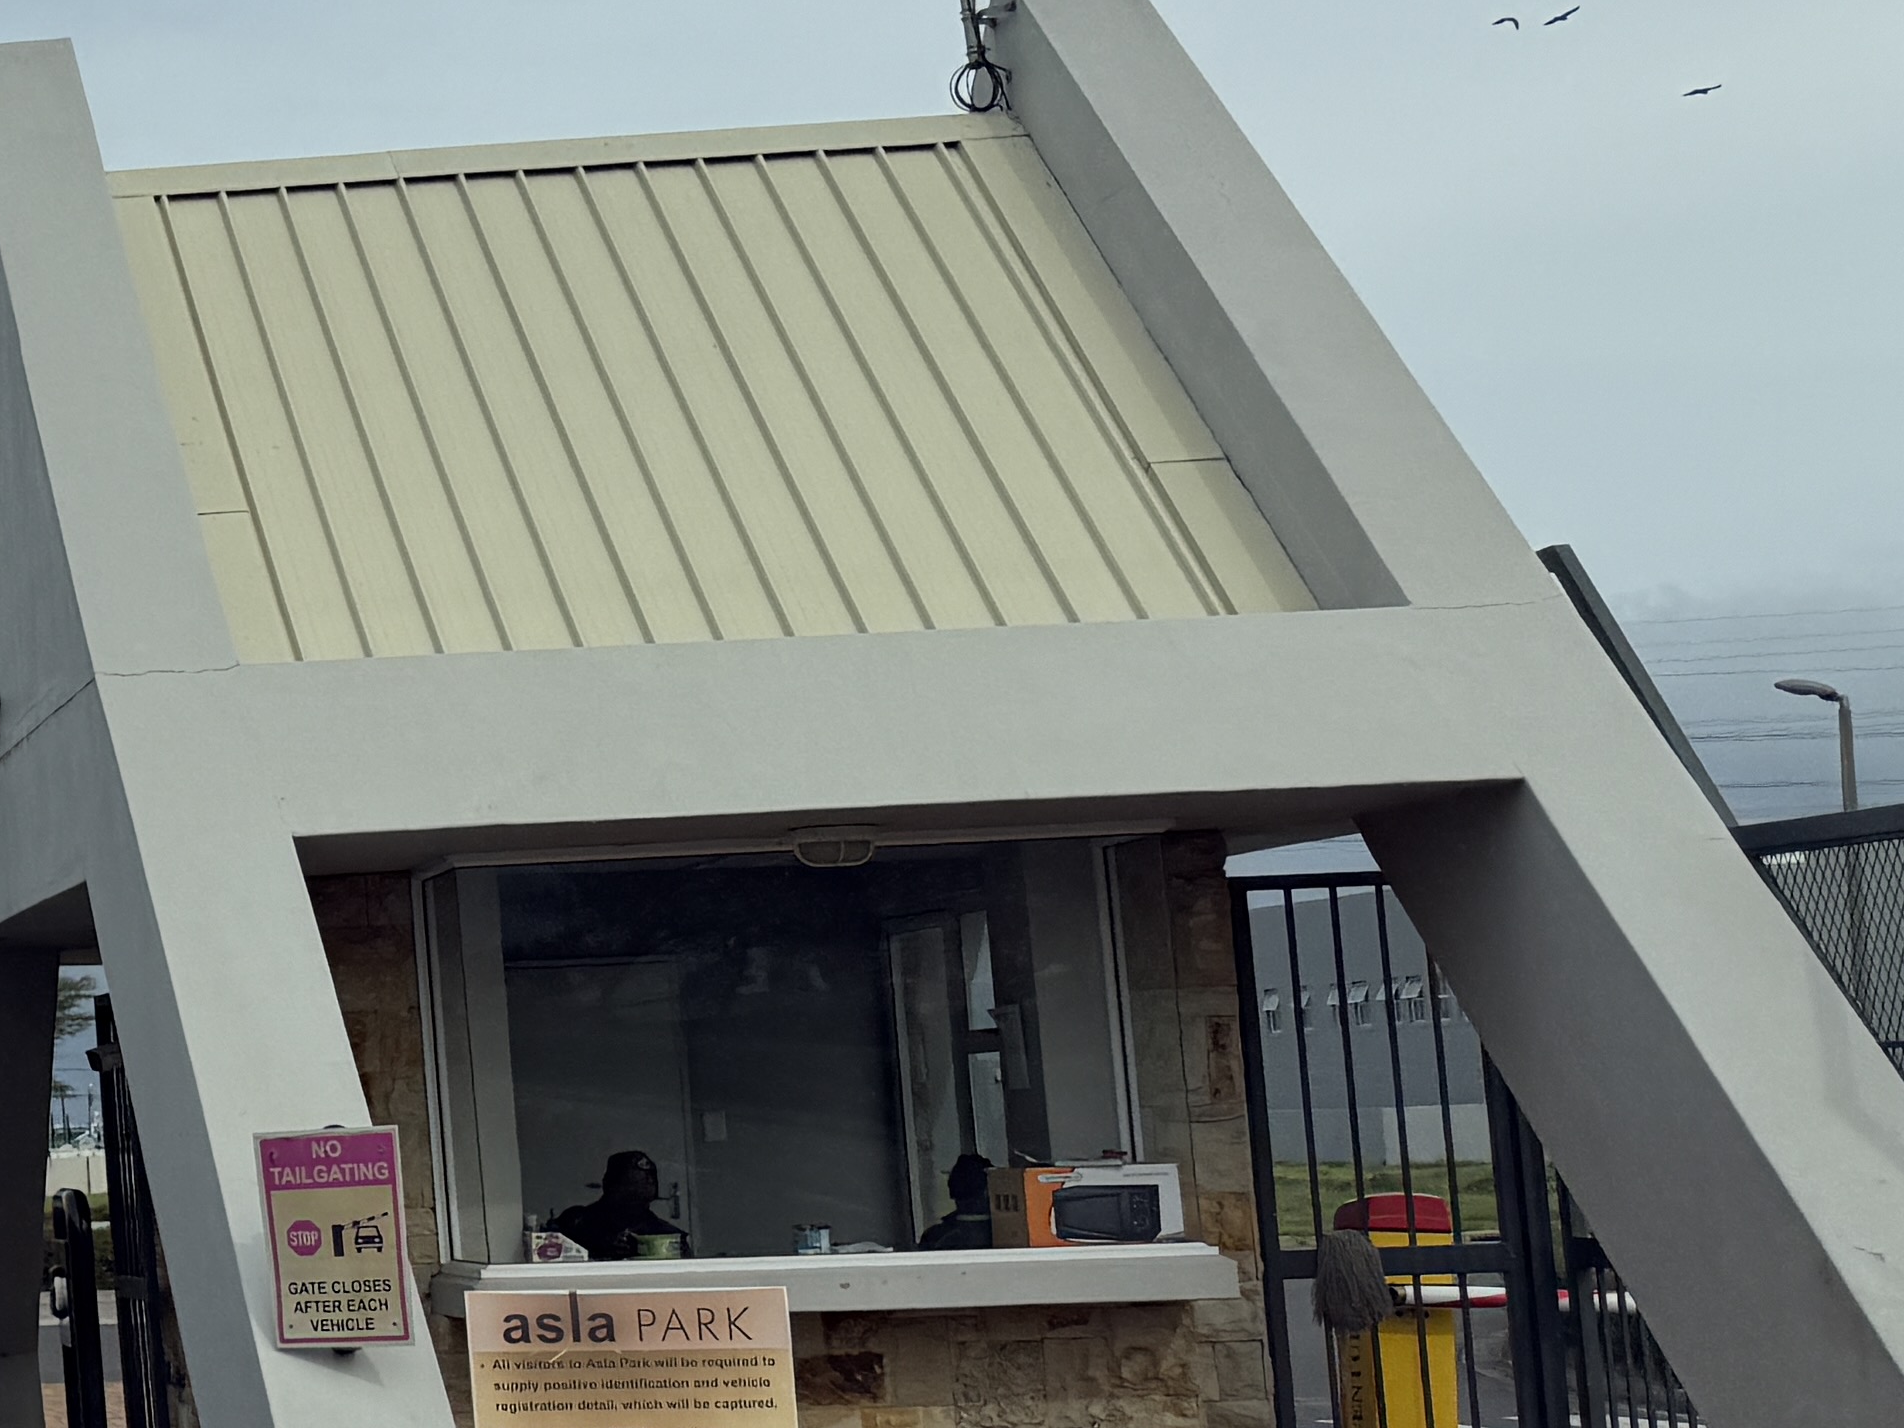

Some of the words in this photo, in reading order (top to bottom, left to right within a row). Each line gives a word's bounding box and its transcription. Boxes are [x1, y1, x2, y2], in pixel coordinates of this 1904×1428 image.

[311, 1140, 341, 1159] NO
[270, 1162, 390, 1185] TAILGATING
[289, 1231, 319, 1246] STOP
[288, 1281, 327, 1296] GATE
[331, 1279, 392, 1293] CLOSES
[294, 1300, 342, 1314] AFTER
[347, 1298, 389, 1312] EACH
[310, 1317, 375, 1332] VEHICLE
[503, 1290, 616, 1344] asla
[637, 1306, 753, 1342] PARK
[492, 1359, 510, 1370] All
[514, 1358, 565, 1370] visitors
[569, 1358, 582, 1369] to
[586, 1358, 616, 1369] Asla
[620, 1357, 651, 1368] Park
[654, 1357, 677, 1368] will
[681, 1357, 698, 1367] be
[702, 1355, 758, 1369] required
[763, 1356, 776, 1366] to
[493, 1380, 538, 1393] supply
[544, 1379, 597, 1392] positive
[601, 1377, 689, 1390] identification
[693, 1377, 718, 1388] and
[723, 1377, 770, 1388] vehicle
[496, 1400, 573, 1414] registration
[621, 1399, 663, 1410] which
[666, 1398, 689, 1409] will
[694, 1398, 709, 1409] be
[714, 1397, 777, 1411] captured.
